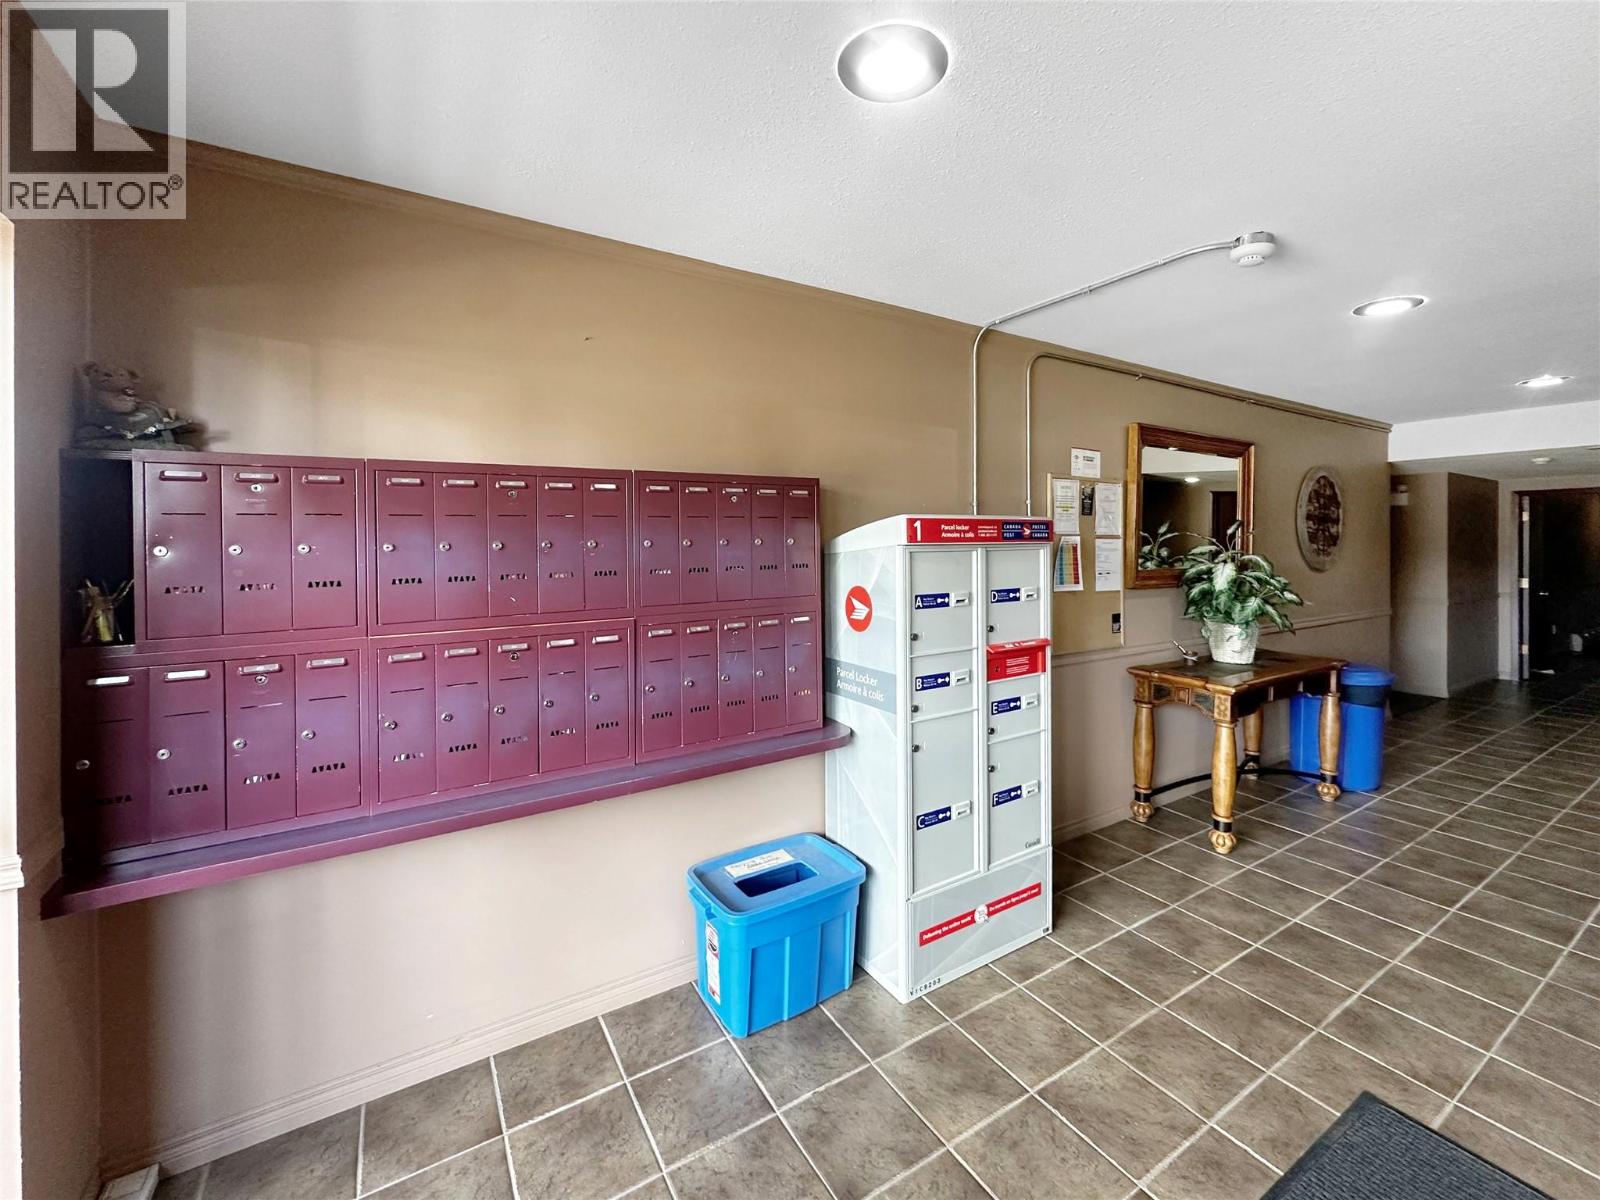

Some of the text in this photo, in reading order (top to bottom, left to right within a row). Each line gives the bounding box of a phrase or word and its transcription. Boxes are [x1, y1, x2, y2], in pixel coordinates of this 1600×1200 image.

[913, 520, 921, 541] 1
[915, 596, 923, 608] A
[991, 591, 998, 602] D
[836, 666, 879, 687] Parcel Locker
[916, 678, 923, 690] B
[836, 680, 885, 702] Armoire à colis
[992, 702, 998, 714] E
[993, 793, 999, 806] F
[917, 815, 925, 828] C
